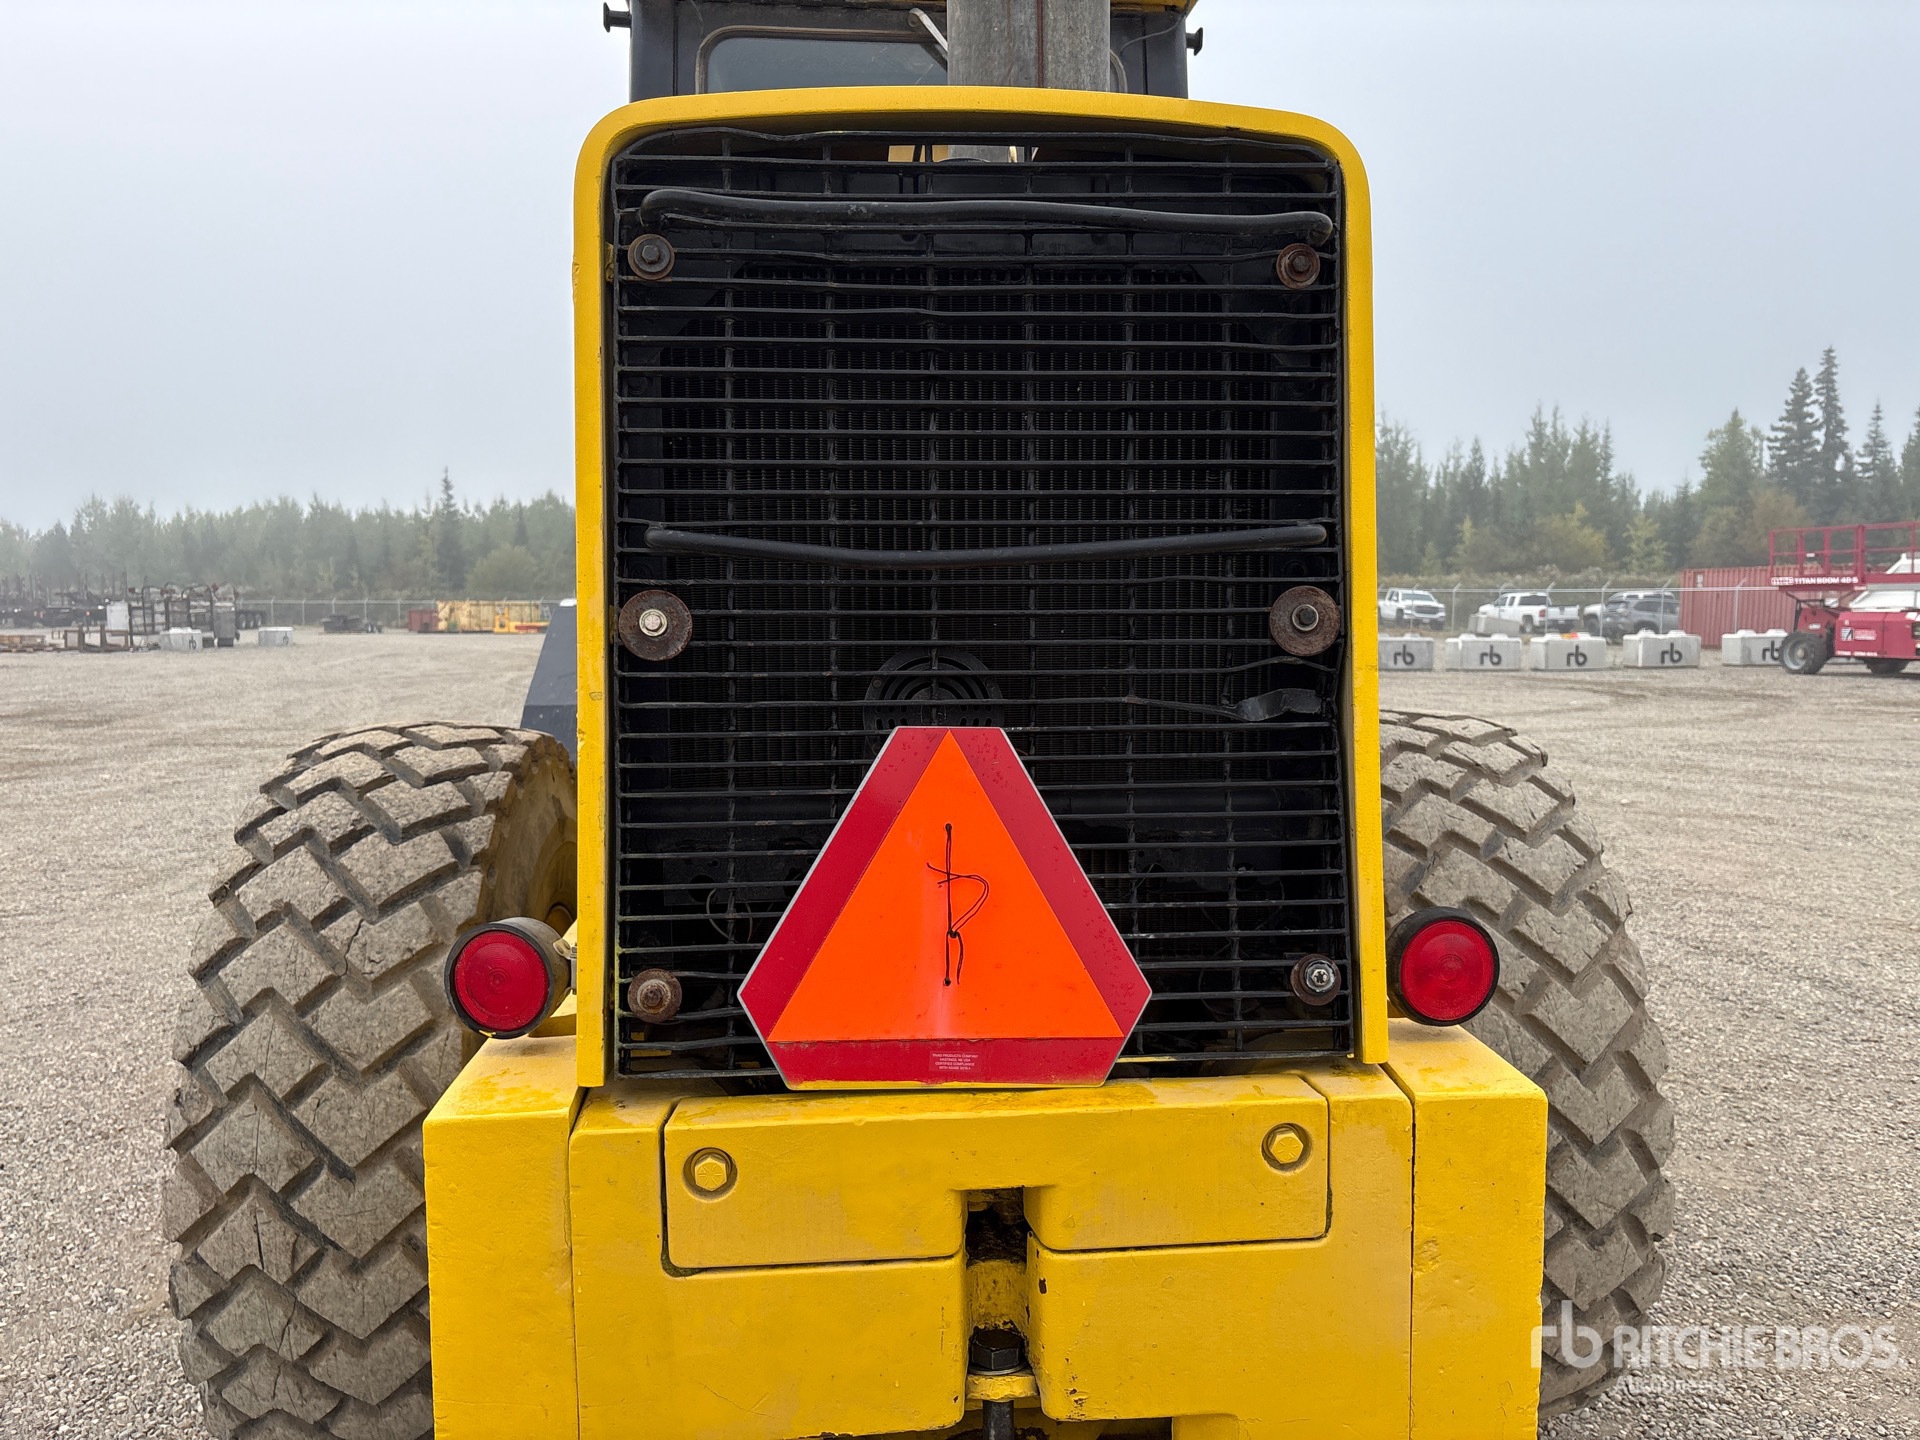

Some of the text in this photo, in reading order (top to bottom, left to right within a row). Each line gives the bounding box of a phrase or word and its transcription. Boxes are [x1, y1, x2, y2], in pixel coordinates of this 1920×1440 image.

[1393, 644, 1415, 666] rb
[1480, 644, 1502, 666] rb
[1566, 645, 1588, 667] rb
[1661, 642, 1683, 664] rb
[1762, 640, 1781, 661] rb
